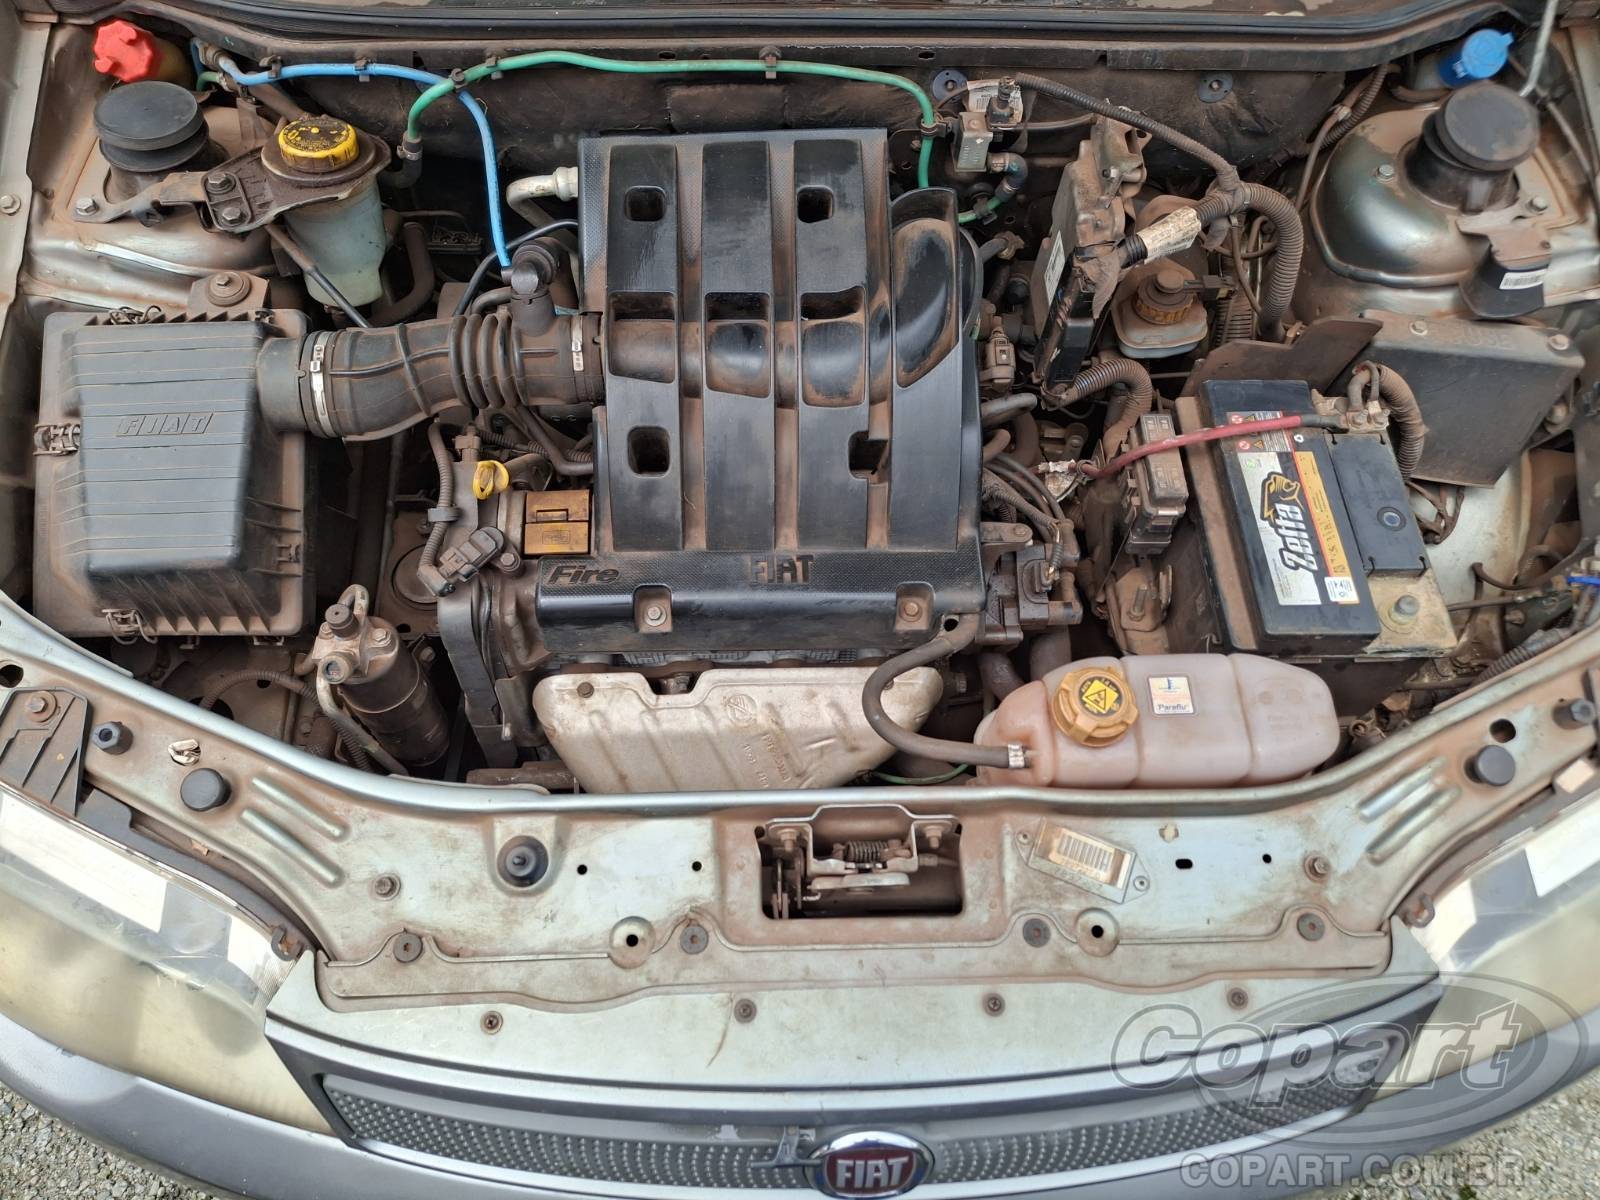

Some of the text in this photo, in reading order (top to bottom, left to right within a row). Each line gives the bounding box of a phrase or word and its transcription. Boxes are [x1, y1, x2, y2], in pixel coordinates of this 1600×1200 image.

[116, 414, 208, 434] FIAT
[1274, 502, 1320, 572] Zetta
[549, 565, 620, 584] Fire
[753, 555, 814, 584] FIAT
[836, 1156, 910, 1188] FIAT
